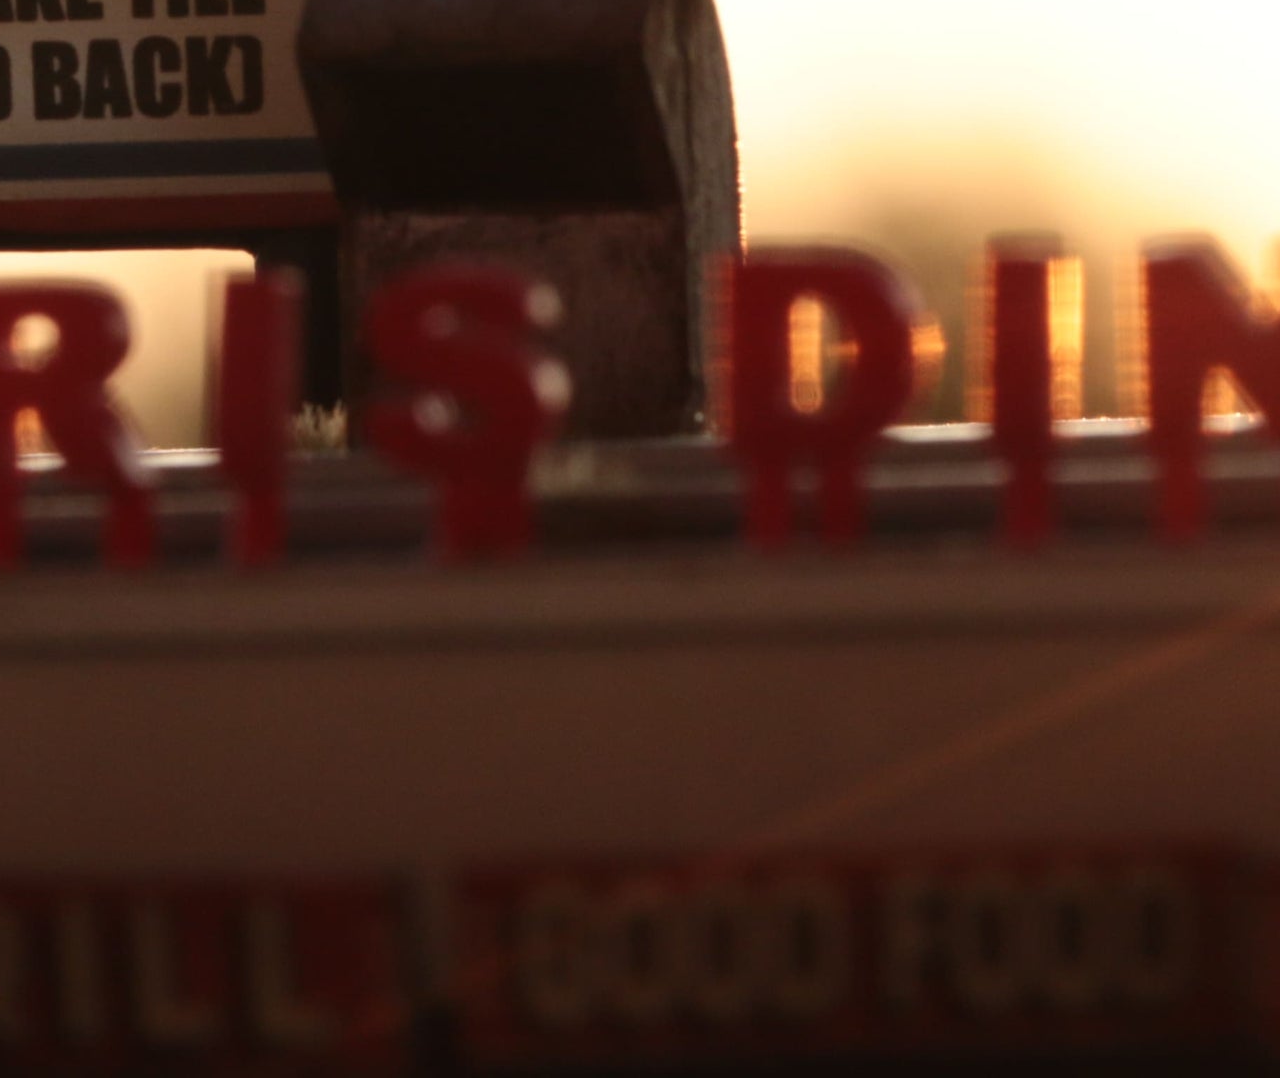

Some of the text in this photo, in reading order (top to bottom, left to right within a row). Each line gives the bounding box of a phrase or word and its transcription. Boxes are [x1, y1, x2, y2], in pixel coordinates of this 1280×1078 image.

[32, 34, 264, 120] BACK)
[518, 865, 1197, 1029] GOOD FOOD
